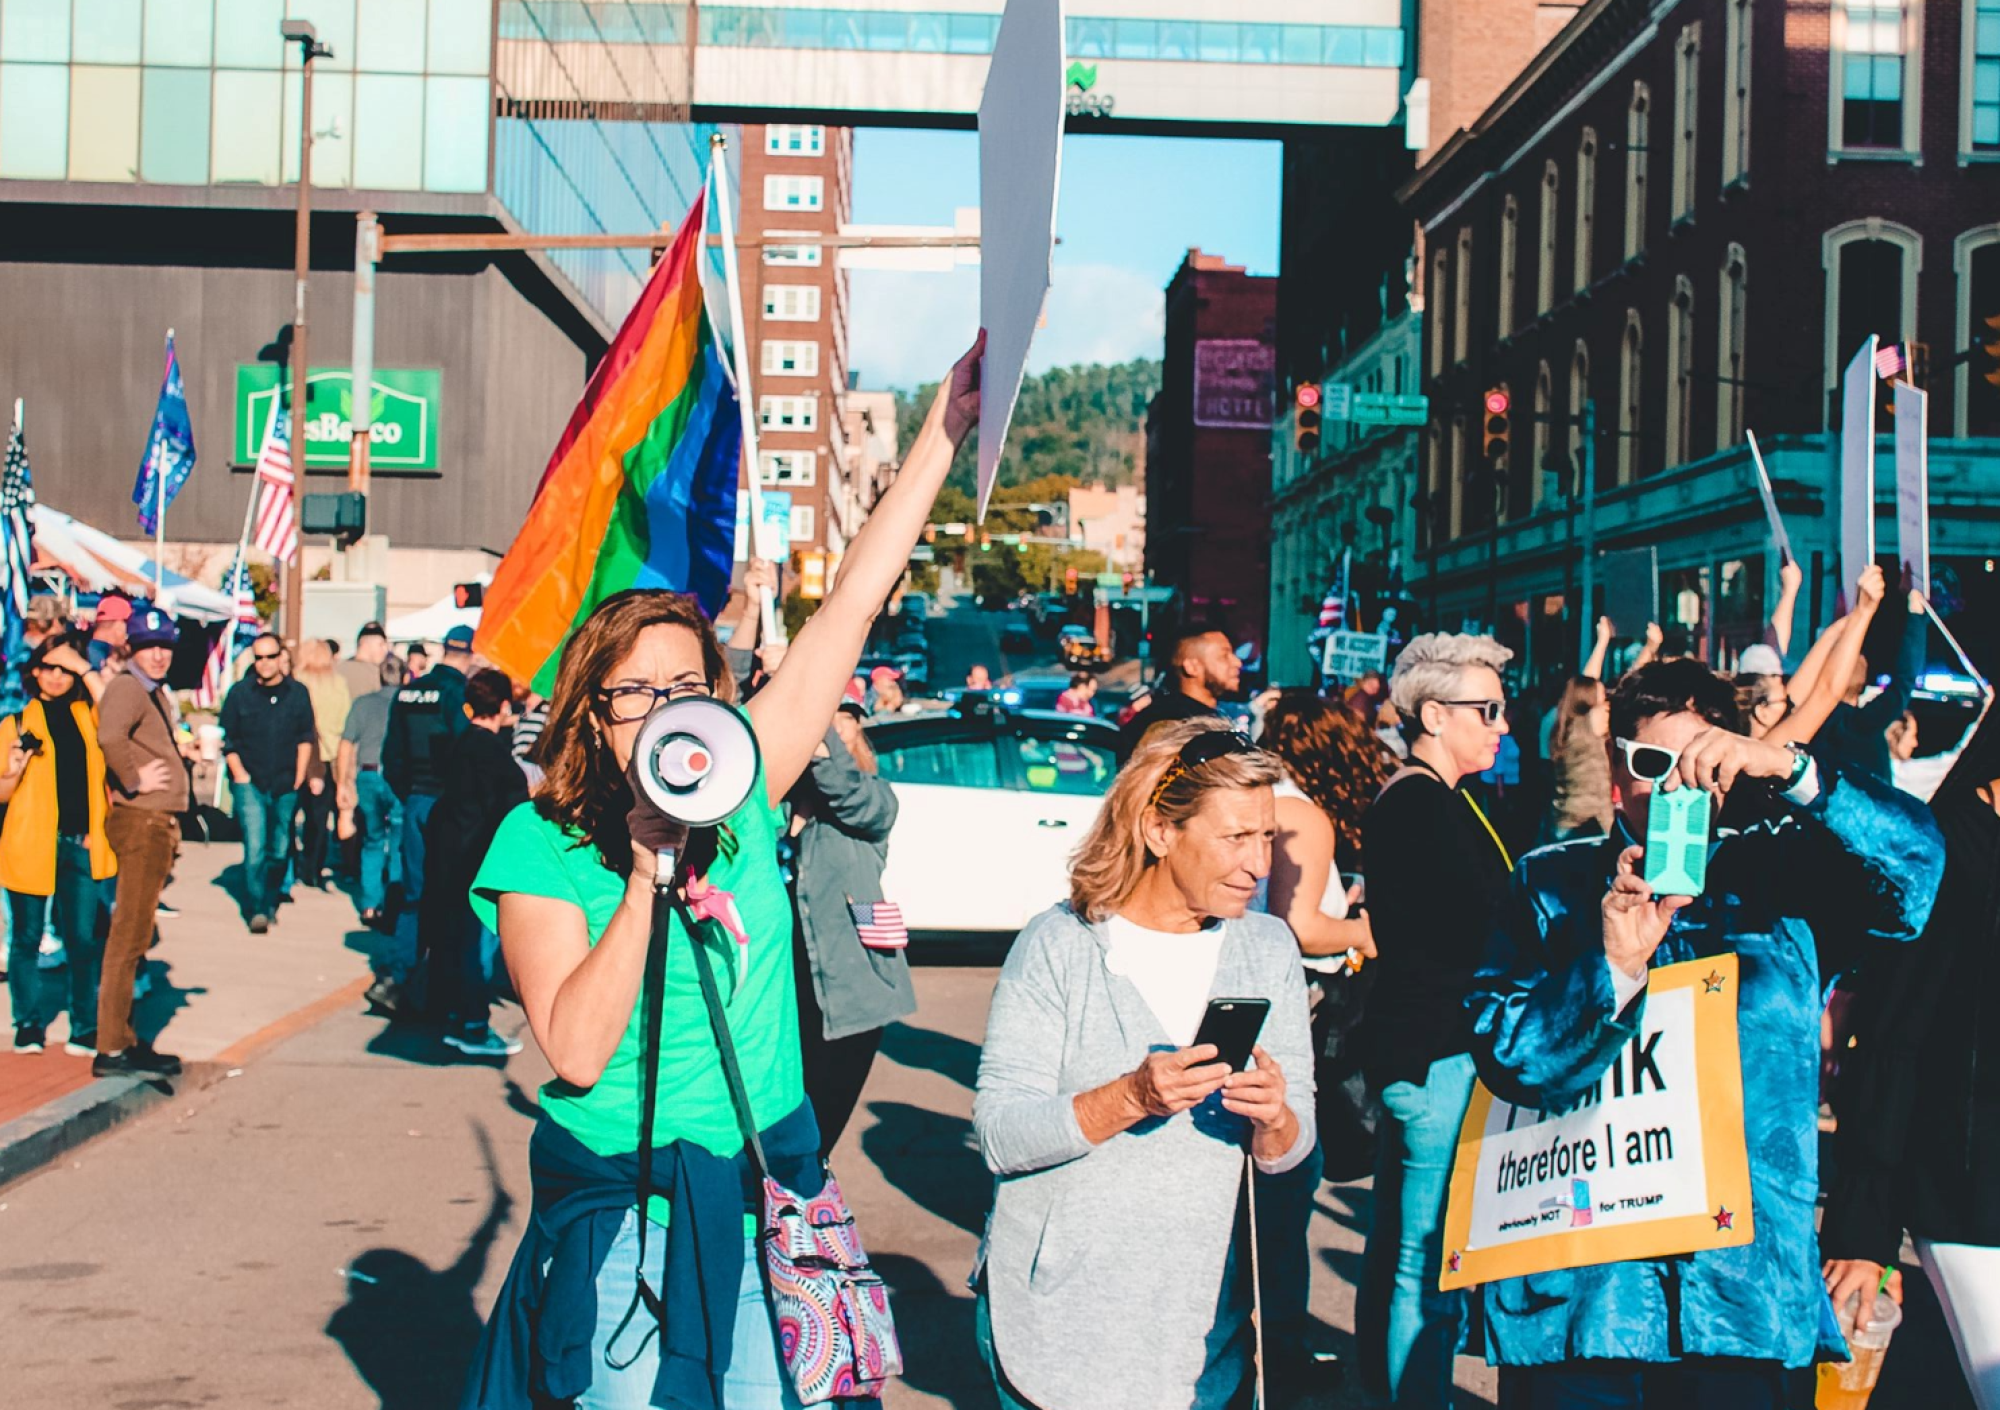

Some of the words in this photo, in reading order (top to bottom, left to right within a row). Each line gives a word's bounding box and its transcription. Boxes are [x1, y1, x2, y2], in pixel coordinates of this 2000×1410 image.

[1497, 1135, 1597, 1194] therefore
[1606, 1124, 1615, 1169] I
[1625, 1126, 1673, 1166] am
[1498, 1215, 1537, 1232] obviously
[1540, 1209, 1561, 1224] NOT
[1599, 1201, 1616, 1212] for
[1619, 1194, 1664, 1210] TRUMP
